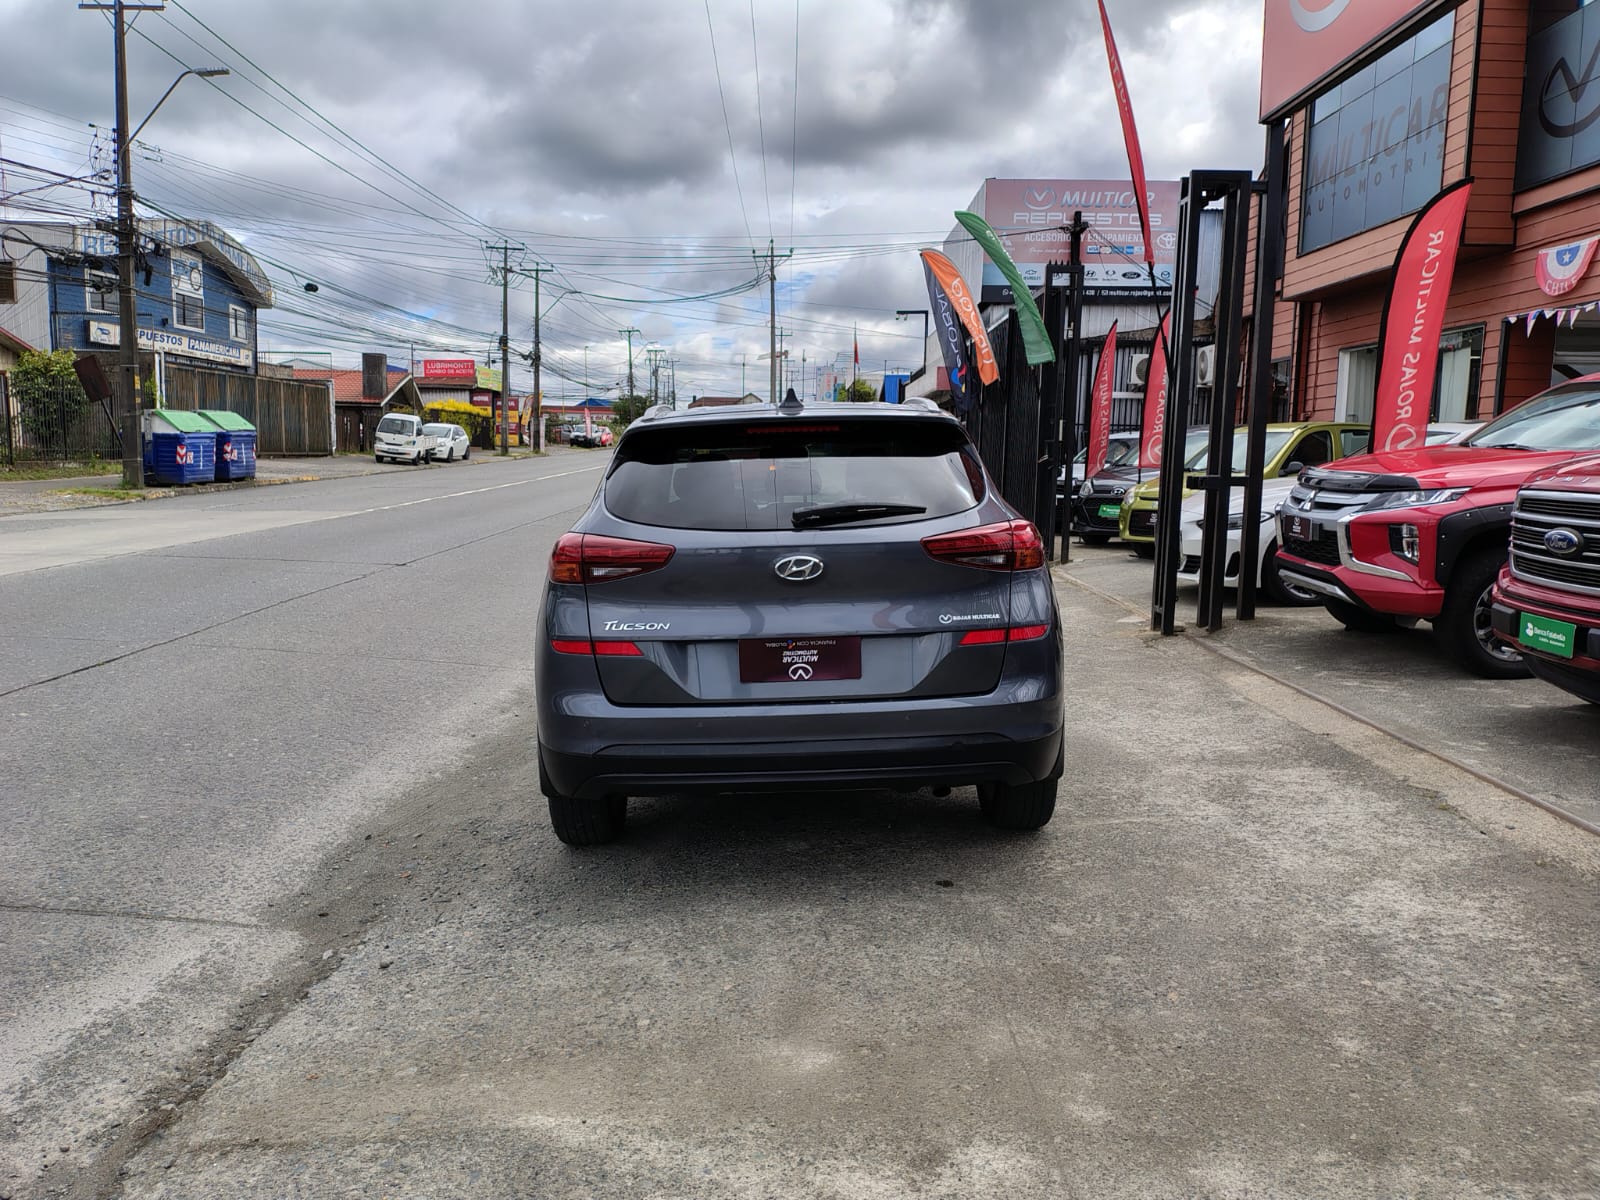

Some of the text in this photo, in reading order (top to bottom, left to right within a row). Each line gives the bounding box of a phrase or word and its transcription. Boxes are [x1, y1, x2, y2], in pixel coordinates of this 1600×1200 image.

[1308, 83, 1449, 195] MULTICAR
[1306, 143, 1444, 217] AUTOMOTRIZ
[1024, 232, 1072, 242] ACCESORIO
[1088, 233, 1143, 242] EQUIPAMIENT
[782, 655, 819, 663] MULTICAR
